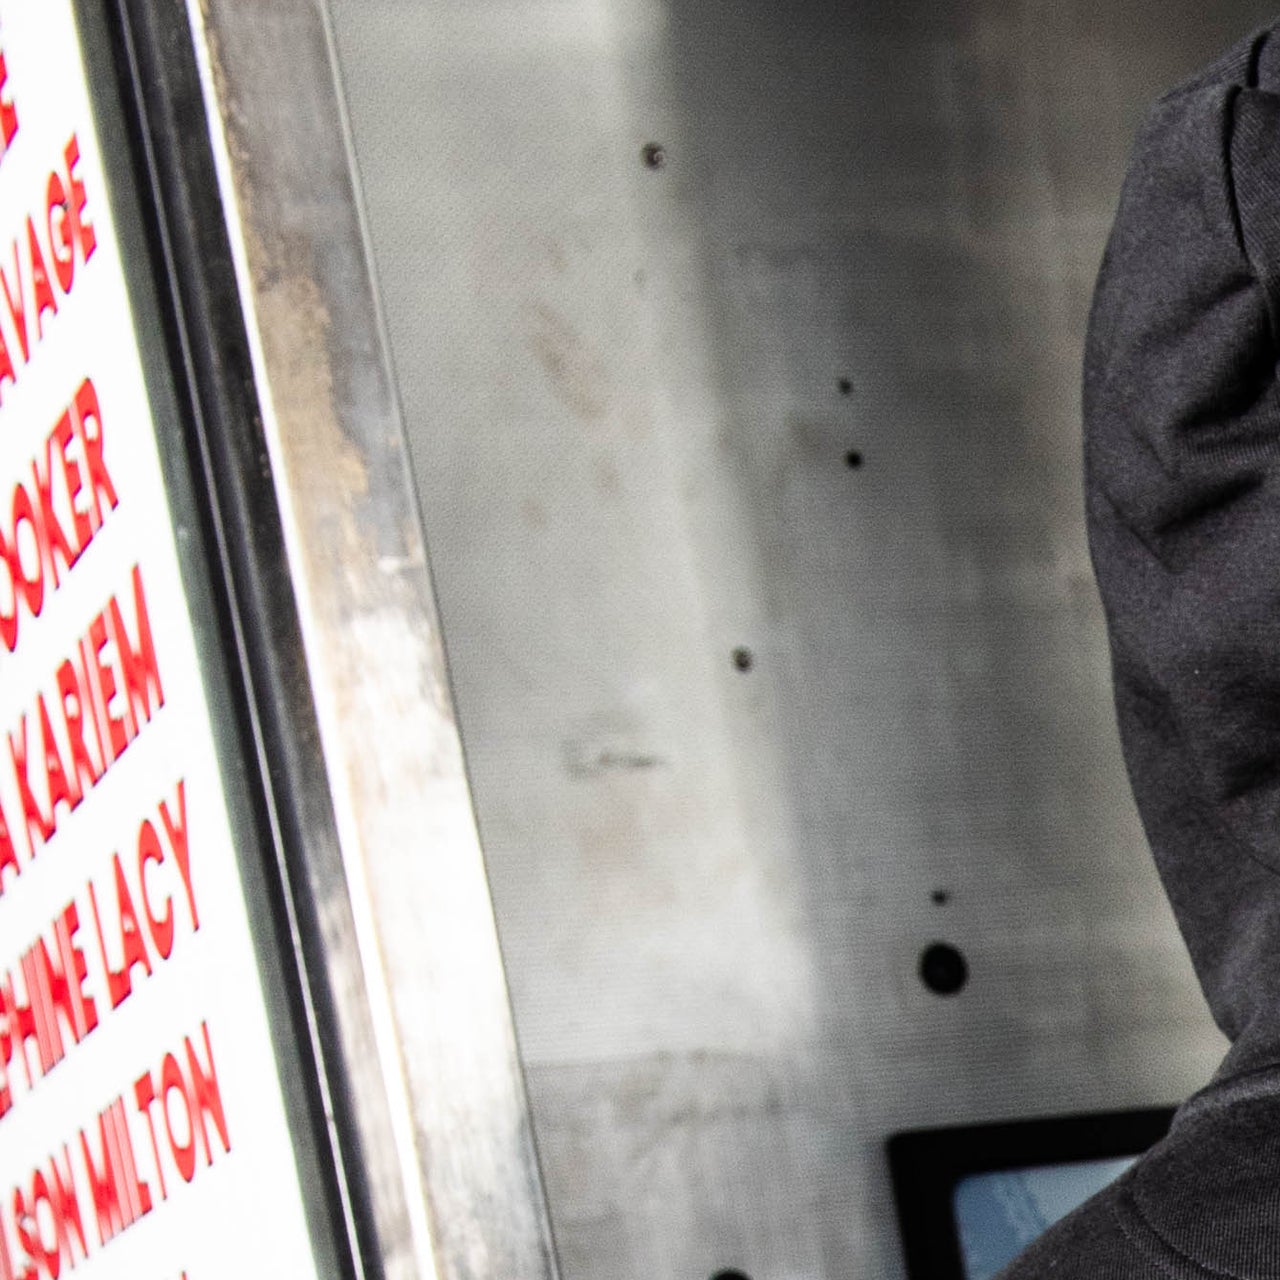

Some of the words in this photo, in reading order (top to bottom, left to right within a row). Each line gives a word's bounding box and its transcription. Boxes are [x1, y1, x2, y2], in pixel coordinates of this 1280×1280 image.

[0, 130, 97, 385] VAGE
[7, 562, 164, 861] KARIEM
[87, 778, 200, 1011] LACY
[78, 1018, 232, 1249] MILTON
